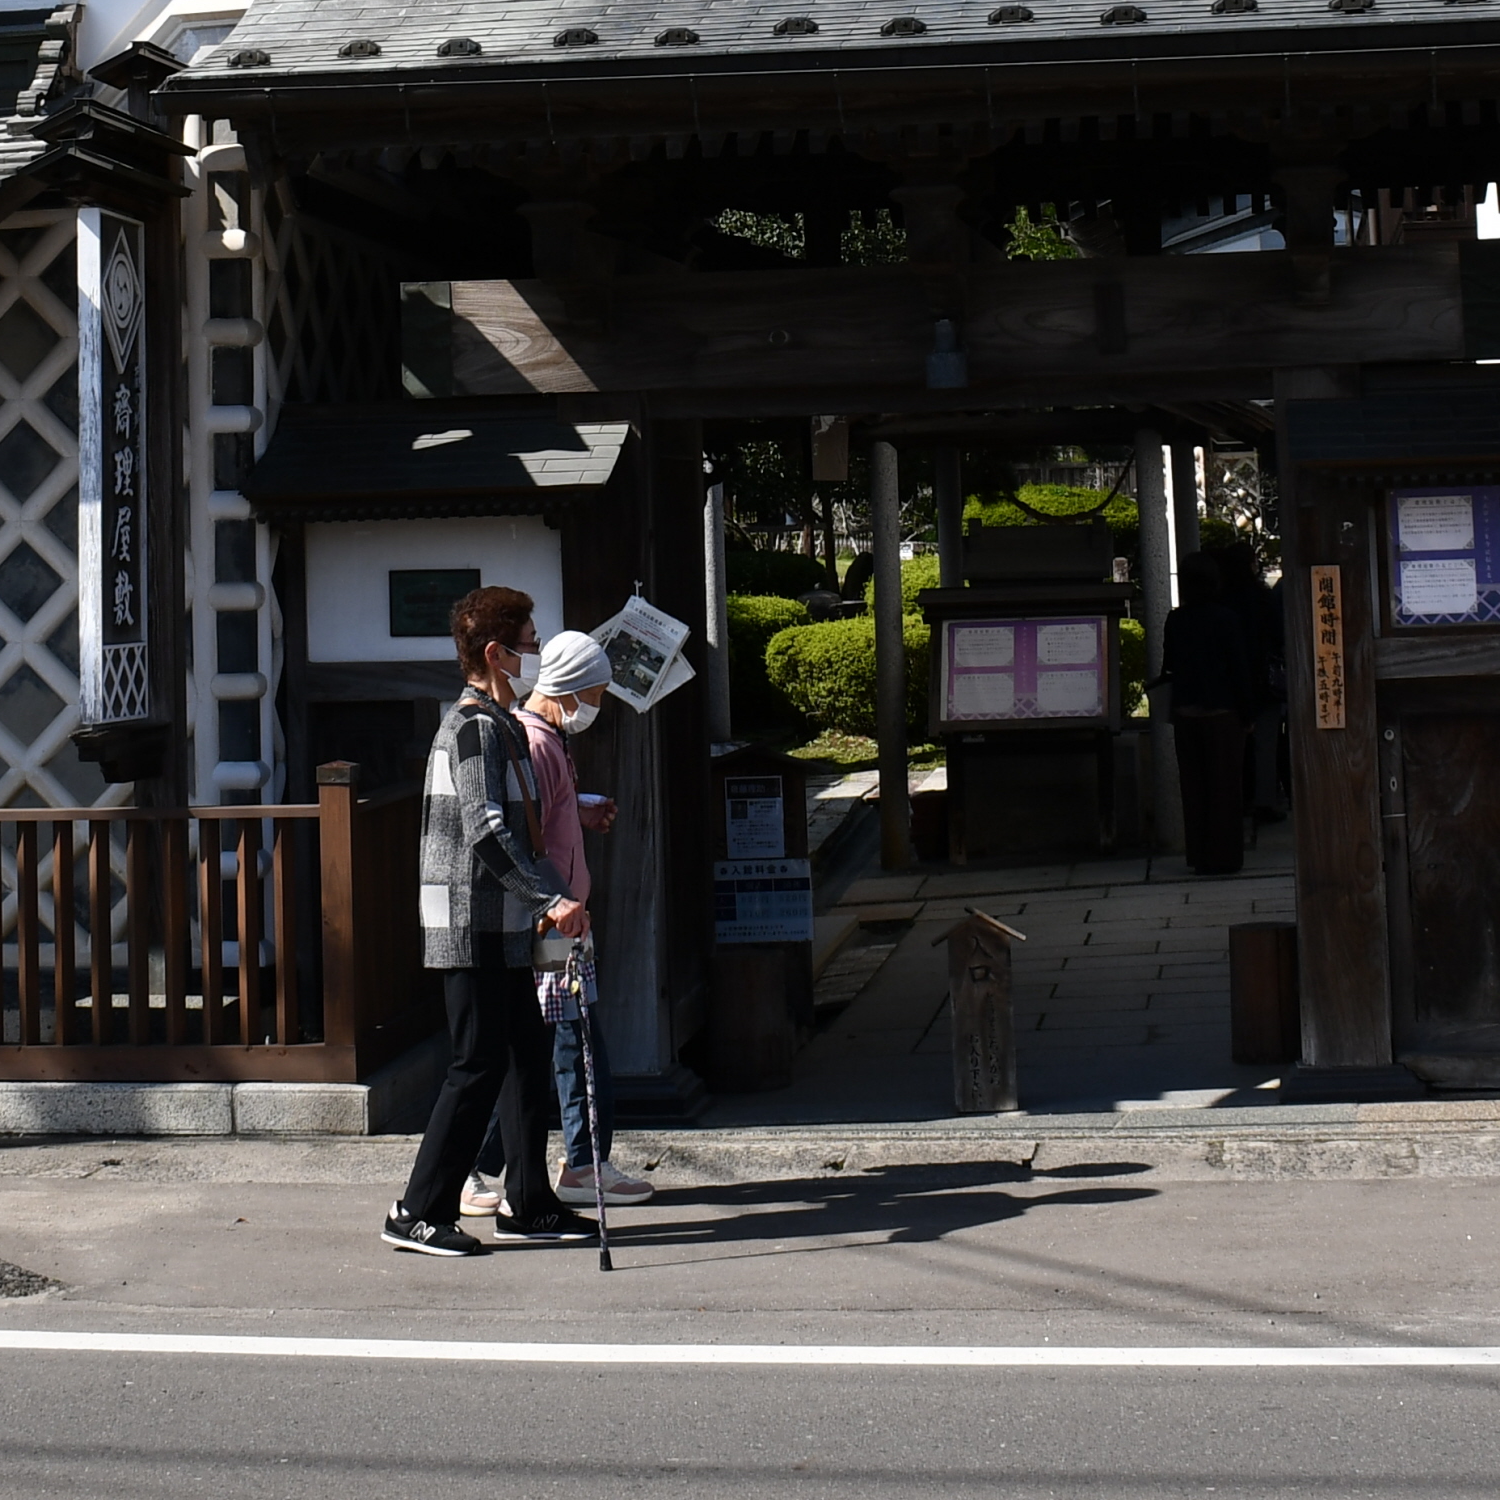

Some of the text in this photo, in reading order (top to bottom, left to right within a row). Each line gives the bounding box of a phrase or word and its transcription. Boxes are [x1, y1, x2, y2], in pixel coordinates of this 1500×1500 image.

[1317, 576, 1339, 646] 開館時間
[968, 935, 993, 983] 入口
